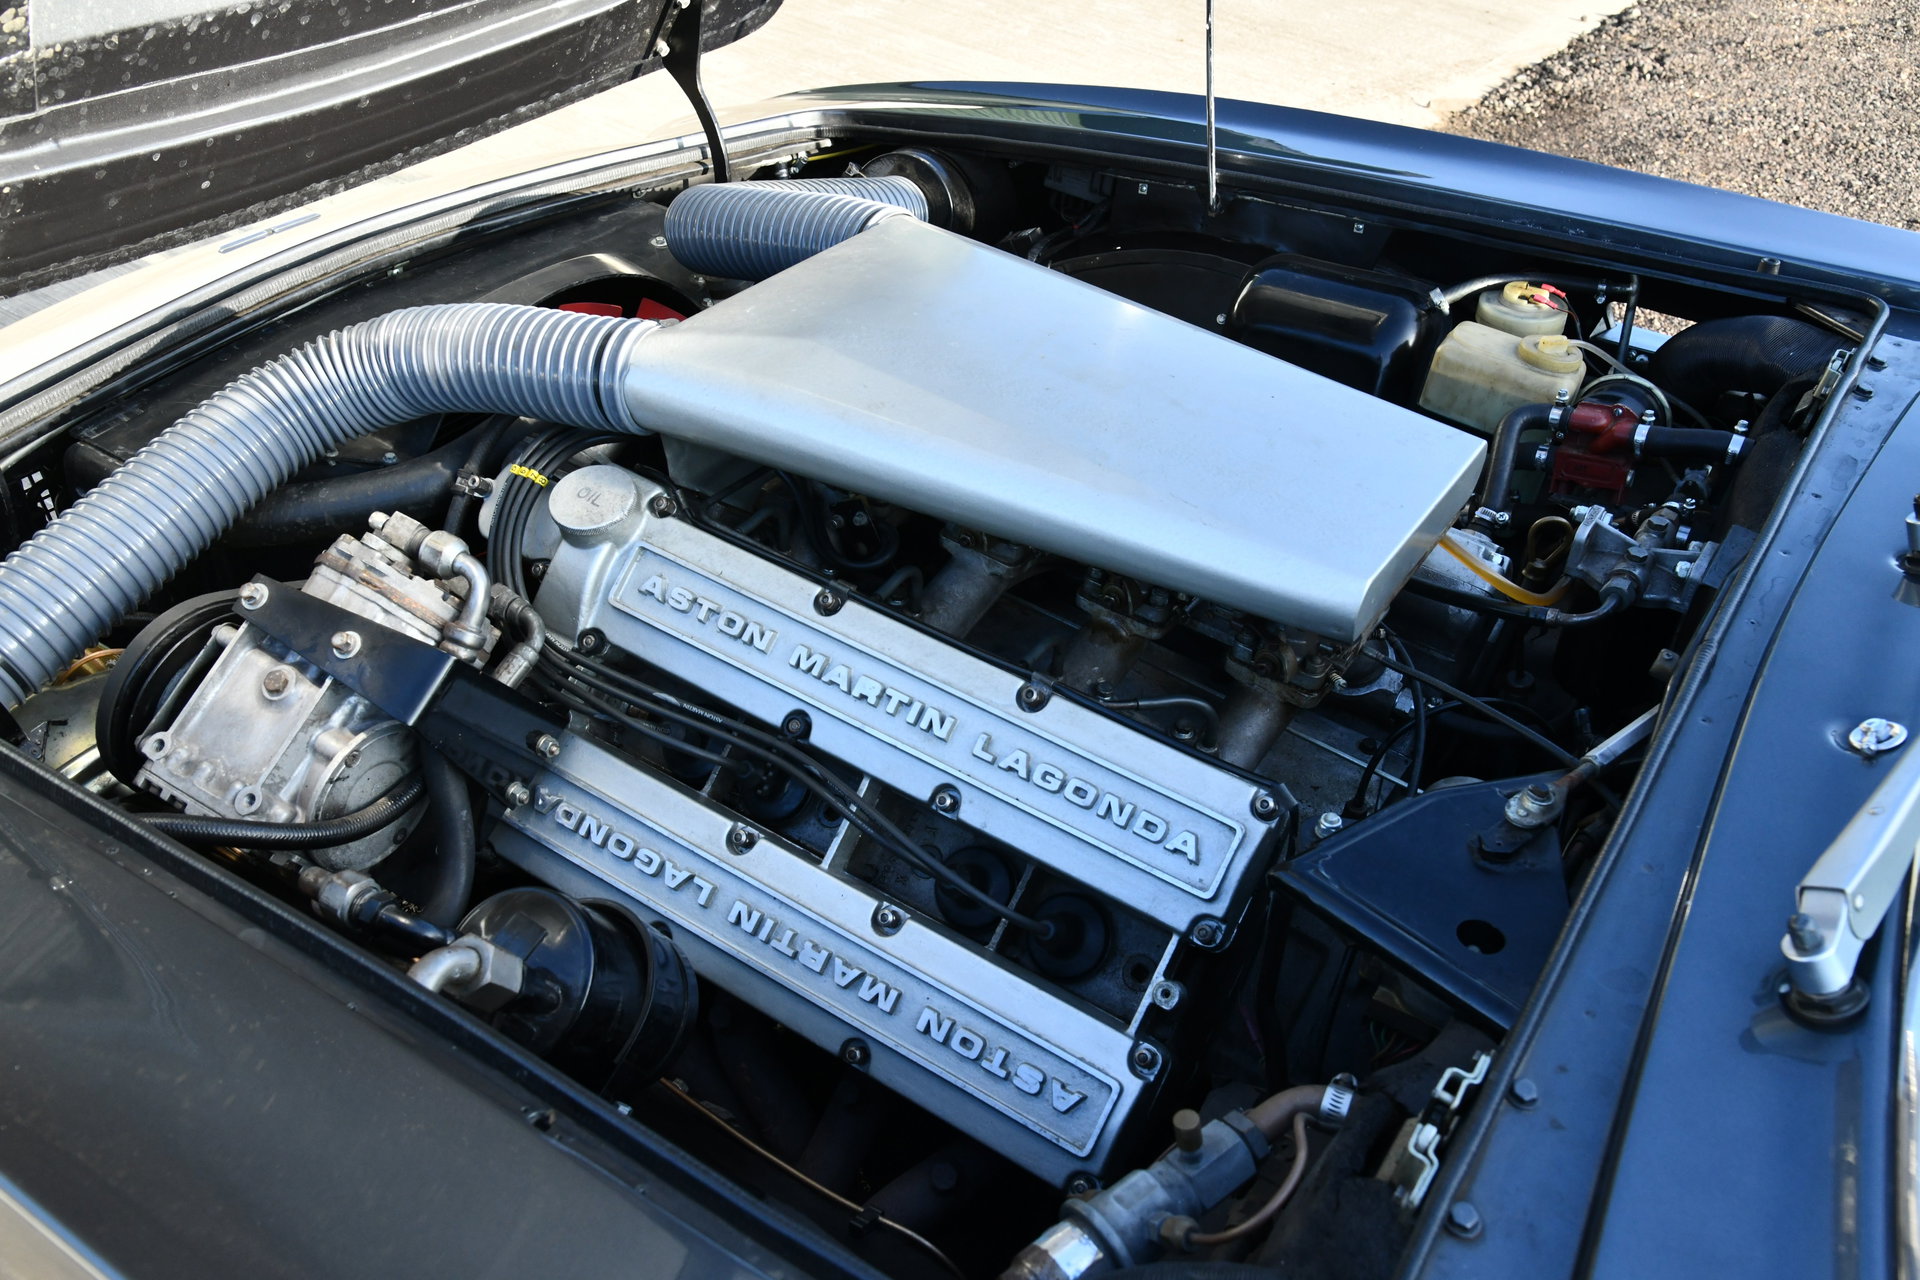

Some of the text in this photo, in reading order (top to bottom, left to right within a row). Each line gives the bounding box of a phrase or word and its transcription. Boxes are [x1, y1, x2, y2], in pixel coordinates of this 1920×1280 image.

[538, 477, 547, 485] 8
[577, 487, 602, 507] OIL
[638, 573, 1200, 865] ASTON MARTIN LAGONDA
[682, 703, 724, 724] ASTON MARTIN
[534, 784, 1088, 1114] ASTON MARTIN LAGONDA
